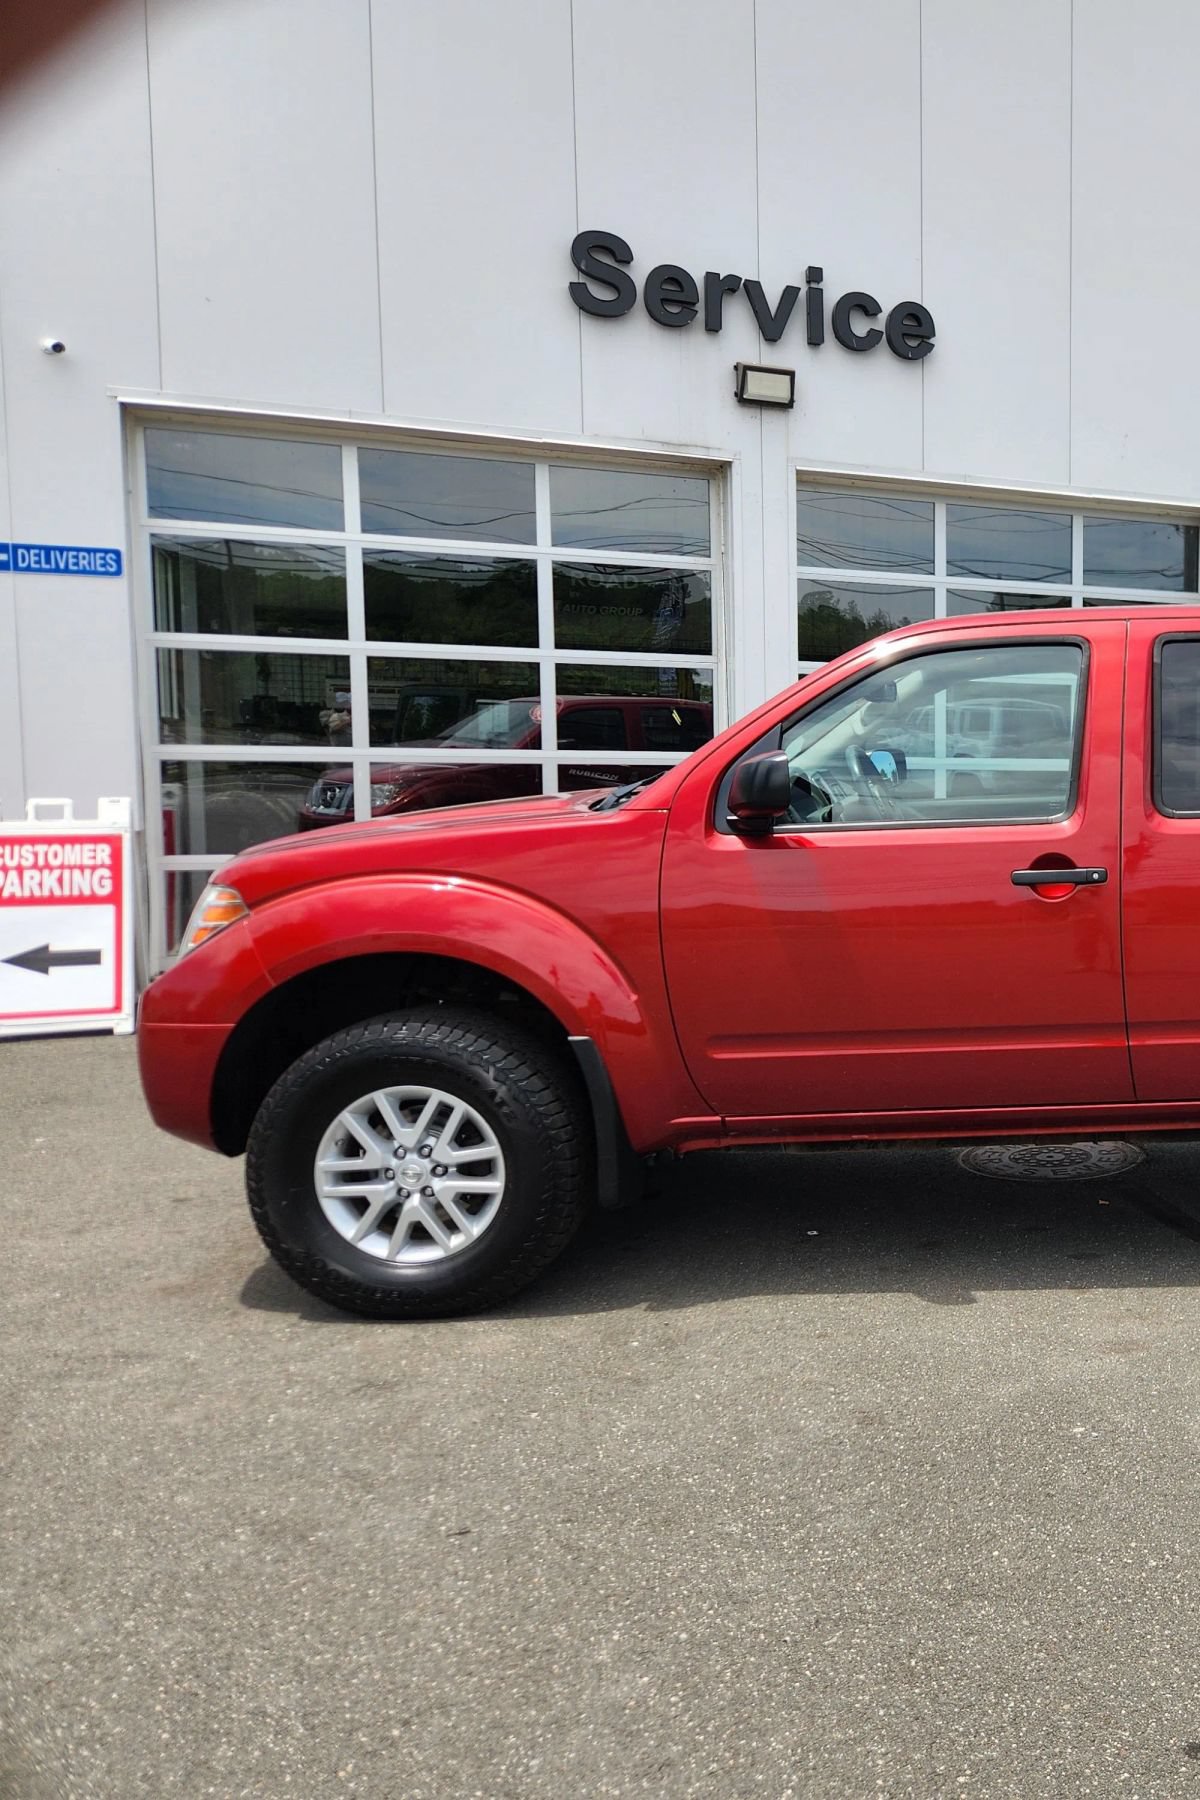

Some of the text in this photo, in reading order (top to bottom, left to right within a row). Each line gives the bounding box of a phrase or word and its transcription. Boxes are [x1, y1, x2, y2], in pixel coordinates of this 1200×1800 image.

[568, 229, 937, 361] Service
[17, 548, 118, 573] DELIVERIES
[562, 603, 644, 617] AUTO GROUP
[568, 767, 620, 781] RUBICON
[0, 843, 112, 867] USTOMER
